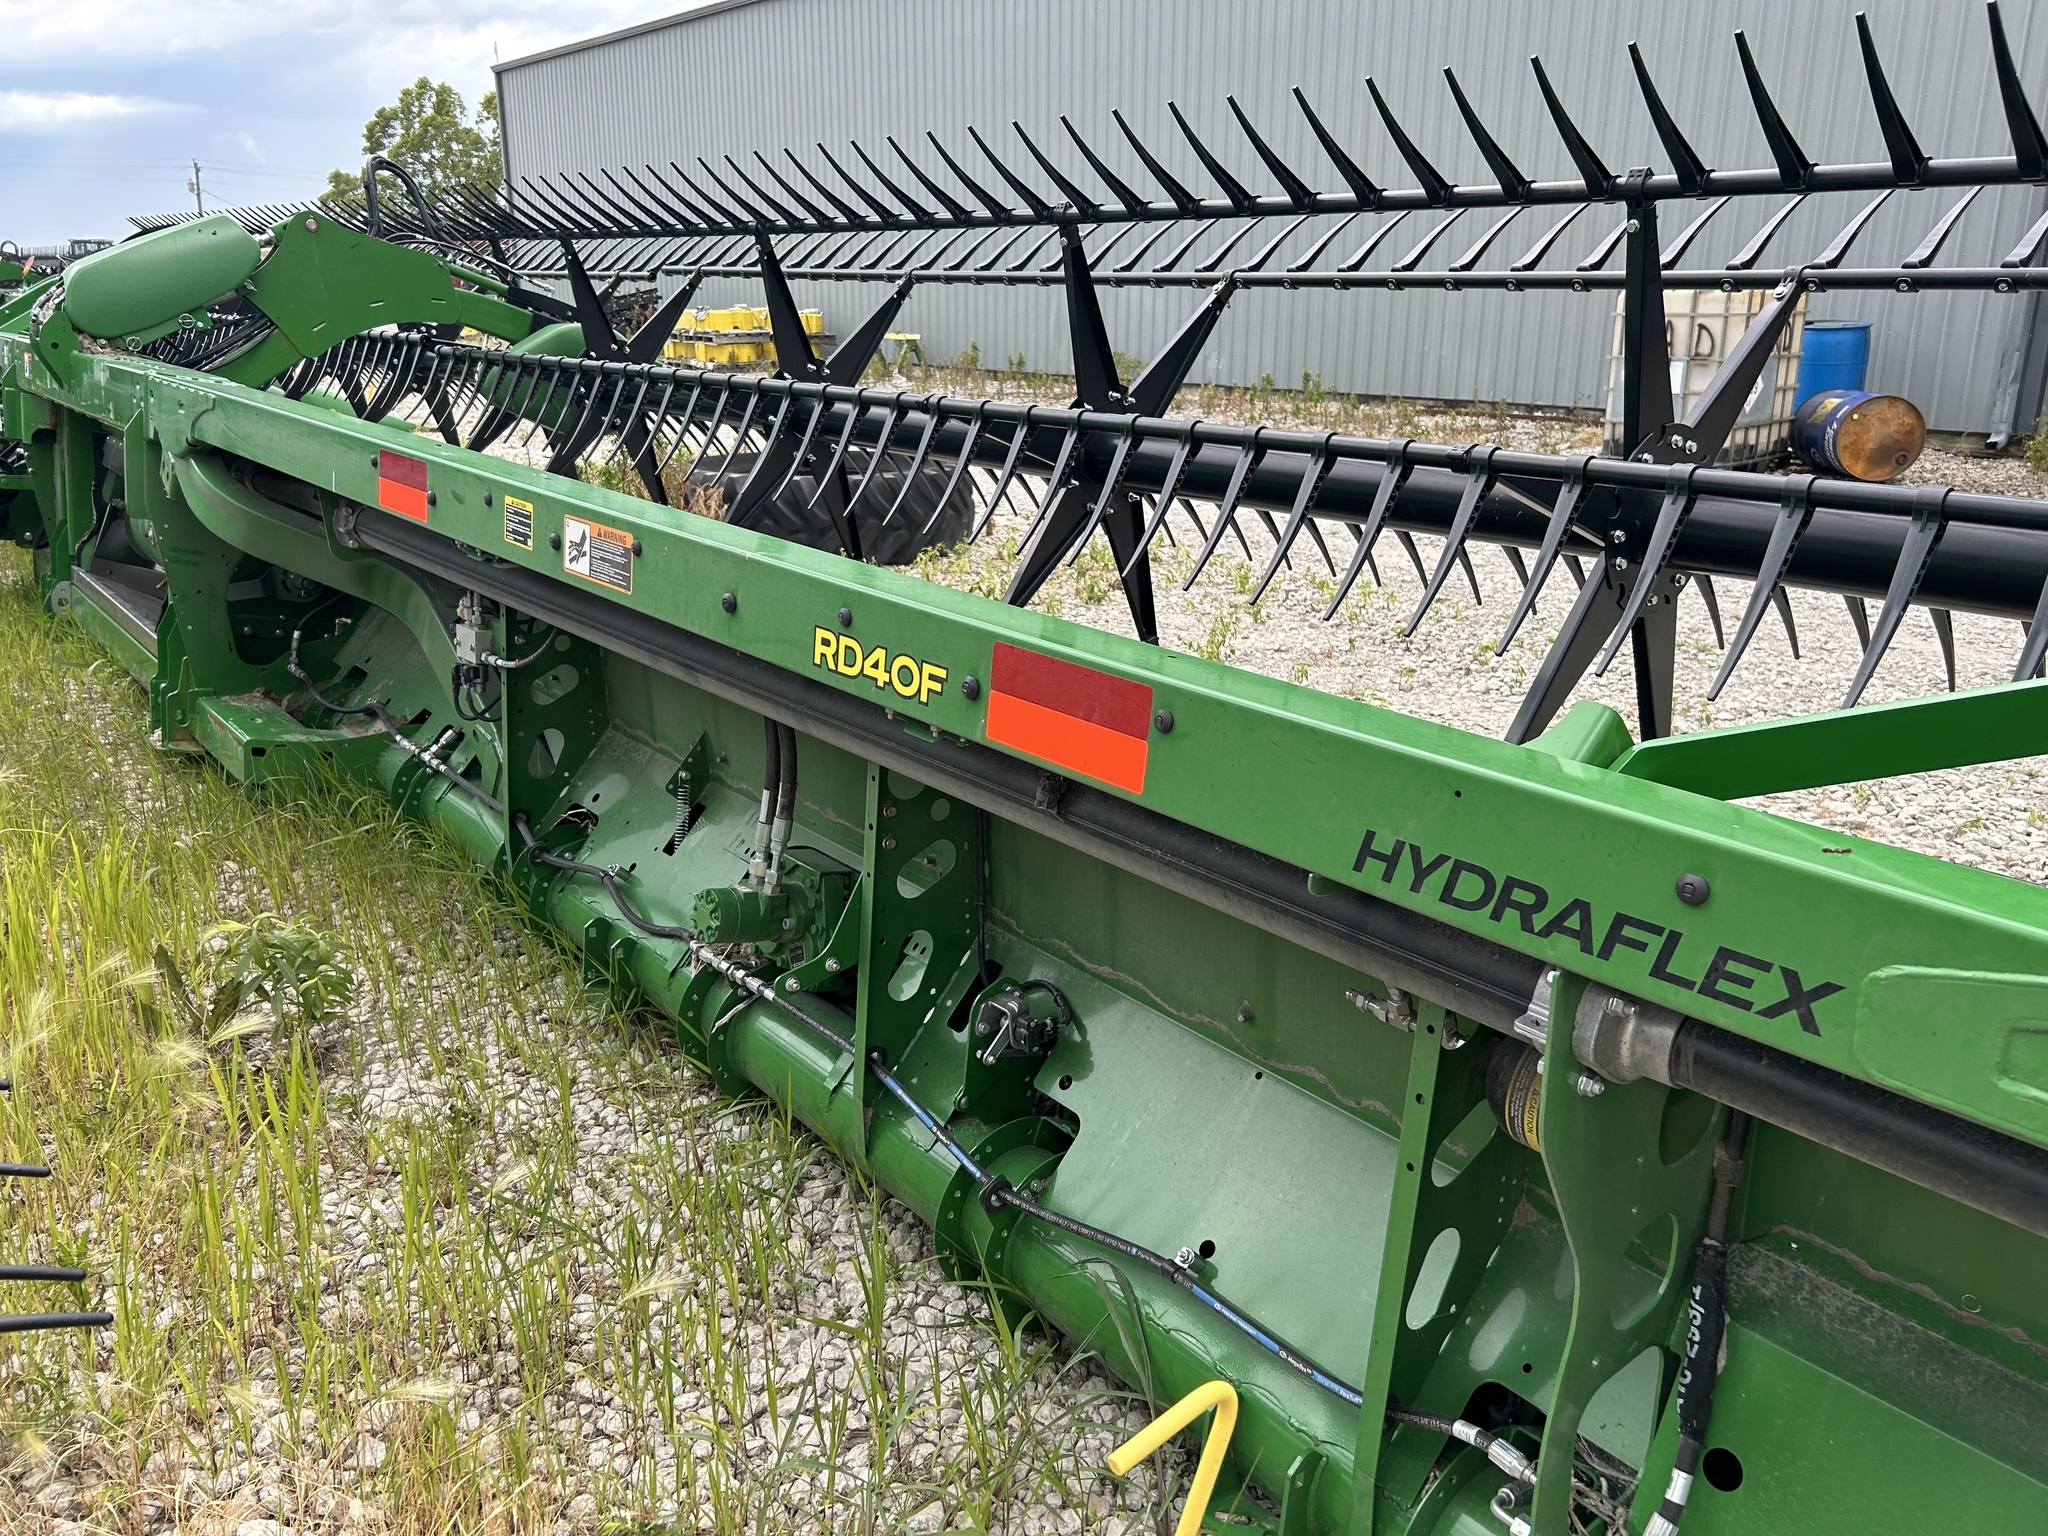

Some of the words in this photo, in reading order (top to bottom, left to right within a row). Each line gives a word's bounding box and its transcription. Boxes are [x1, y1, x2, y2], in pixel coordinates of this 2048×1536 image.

[603, 528, 627, 545] WARNING
[813, 624, 949, 706] RD40F
[1352, 829, 1846, 1037] HYDRAFLEX
[1526, 1098, 1537, 1134] CAUTION
[1137, 1250, 1150, 1261] Flame
[1476, 1437, 1487, 1448] R17
